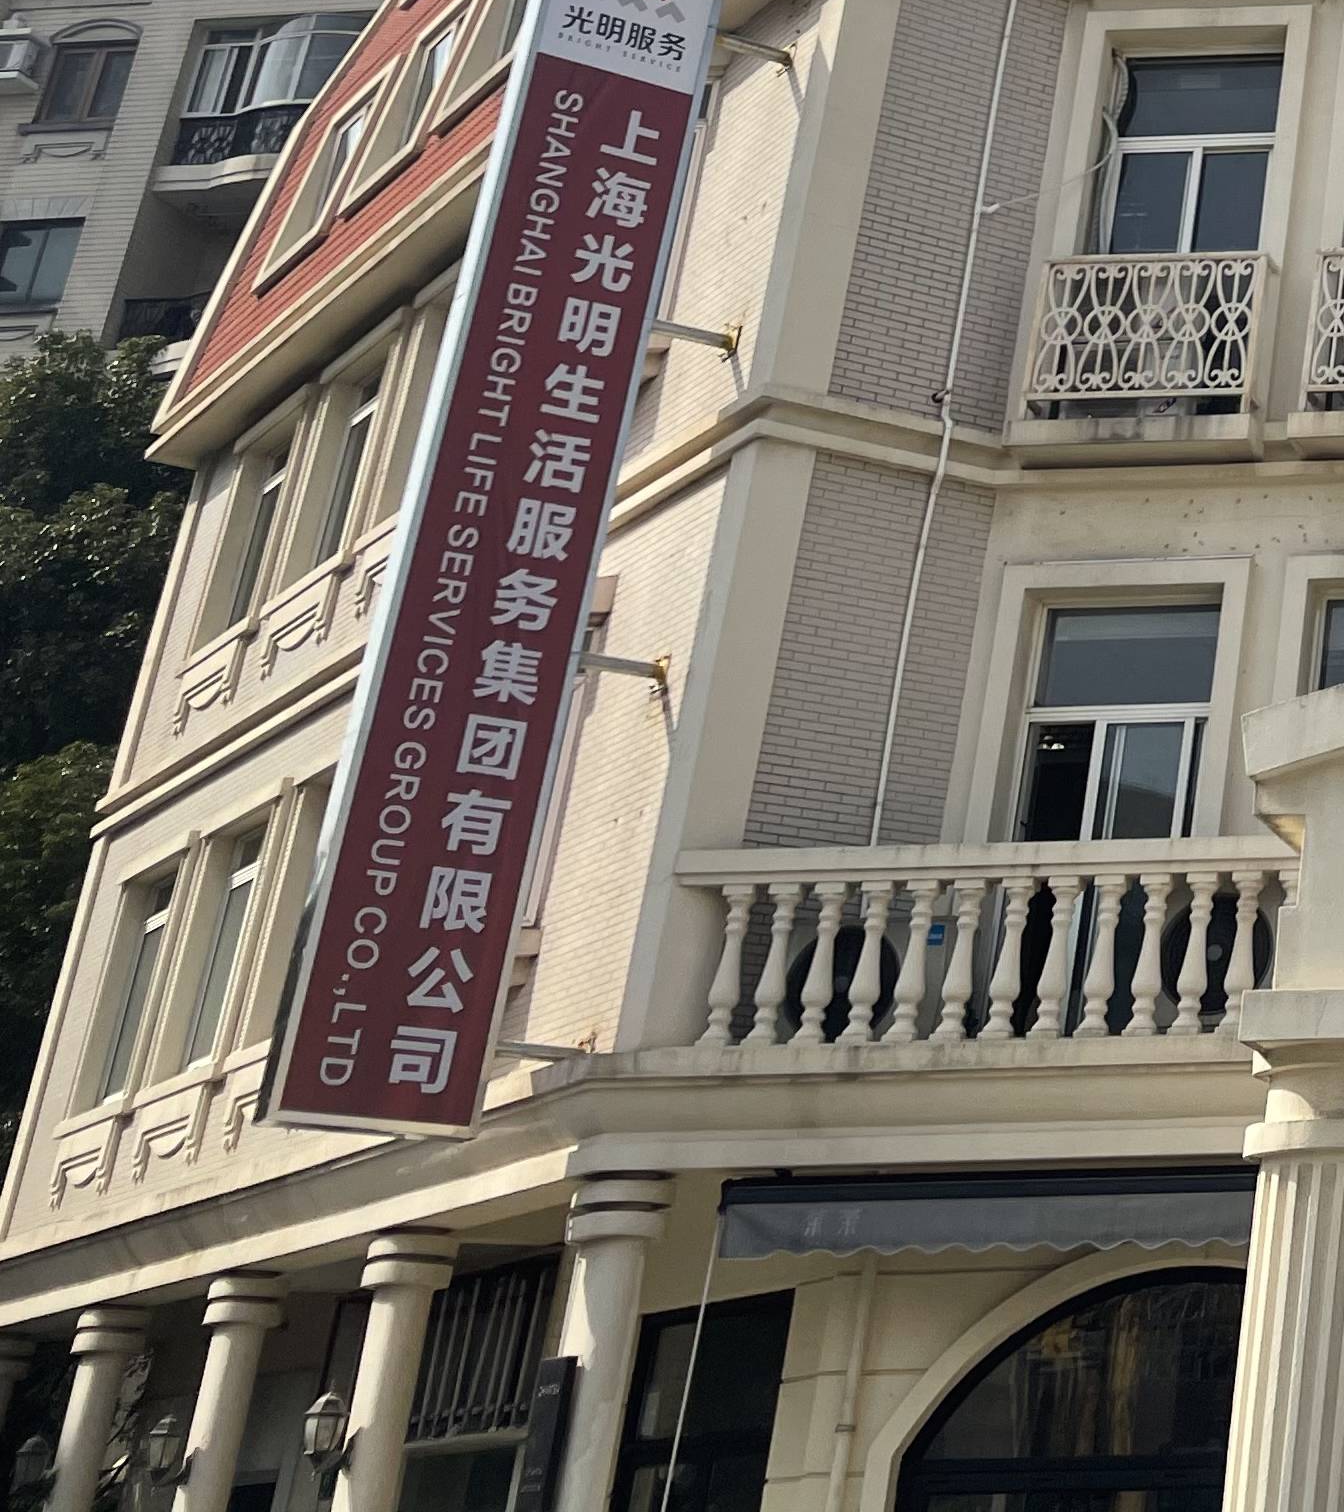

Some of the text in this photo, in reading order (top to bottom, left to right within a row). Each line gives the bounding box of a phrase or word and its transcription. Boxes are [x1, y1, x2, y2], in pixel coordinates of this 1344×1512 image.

[562, 5, 686, 61] 光明服务
[512, 89, 584, 277] SHANGHAI
[477, 283, 538, 426] BRIGHT
[454, 432, 504, 517] LIFE
[388, 109, 662, 1094] 上海光明生活服务集团有限公司
[402, 524, 480, 730] SERVICES
[365, 741, 428, 896] GROUP
